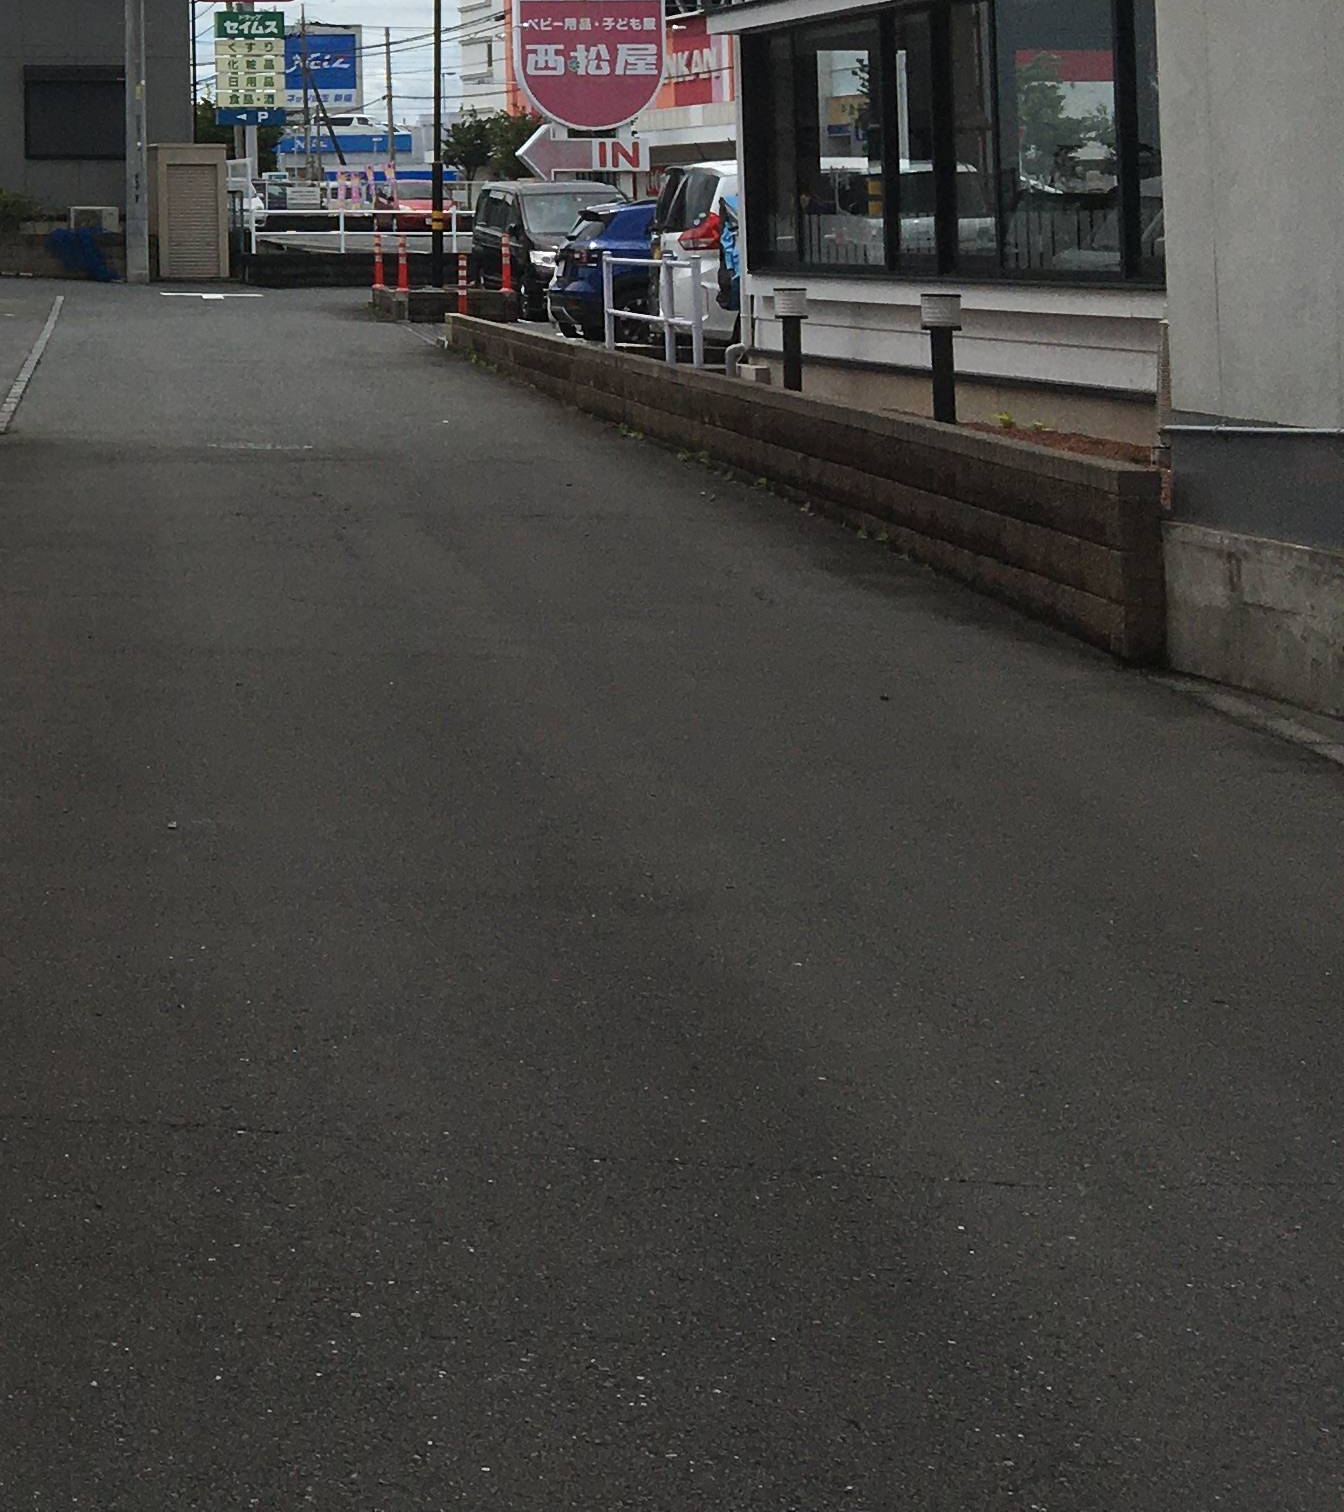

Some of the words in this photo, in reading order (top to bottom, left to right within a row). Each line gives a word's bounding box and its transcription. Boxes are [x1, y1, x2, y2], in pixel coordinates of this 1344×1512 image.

[223, 20, 279, 35] セイムス
[227, 42, 274, 53] くすり
[227, 59, 275, 70] 化粧品
[525, 44, 658, 76] 西松屋
[228, 76, 275, 87] 日用品
[257, 112, 269, 123] P
[598, 141, 640, 169] IN
